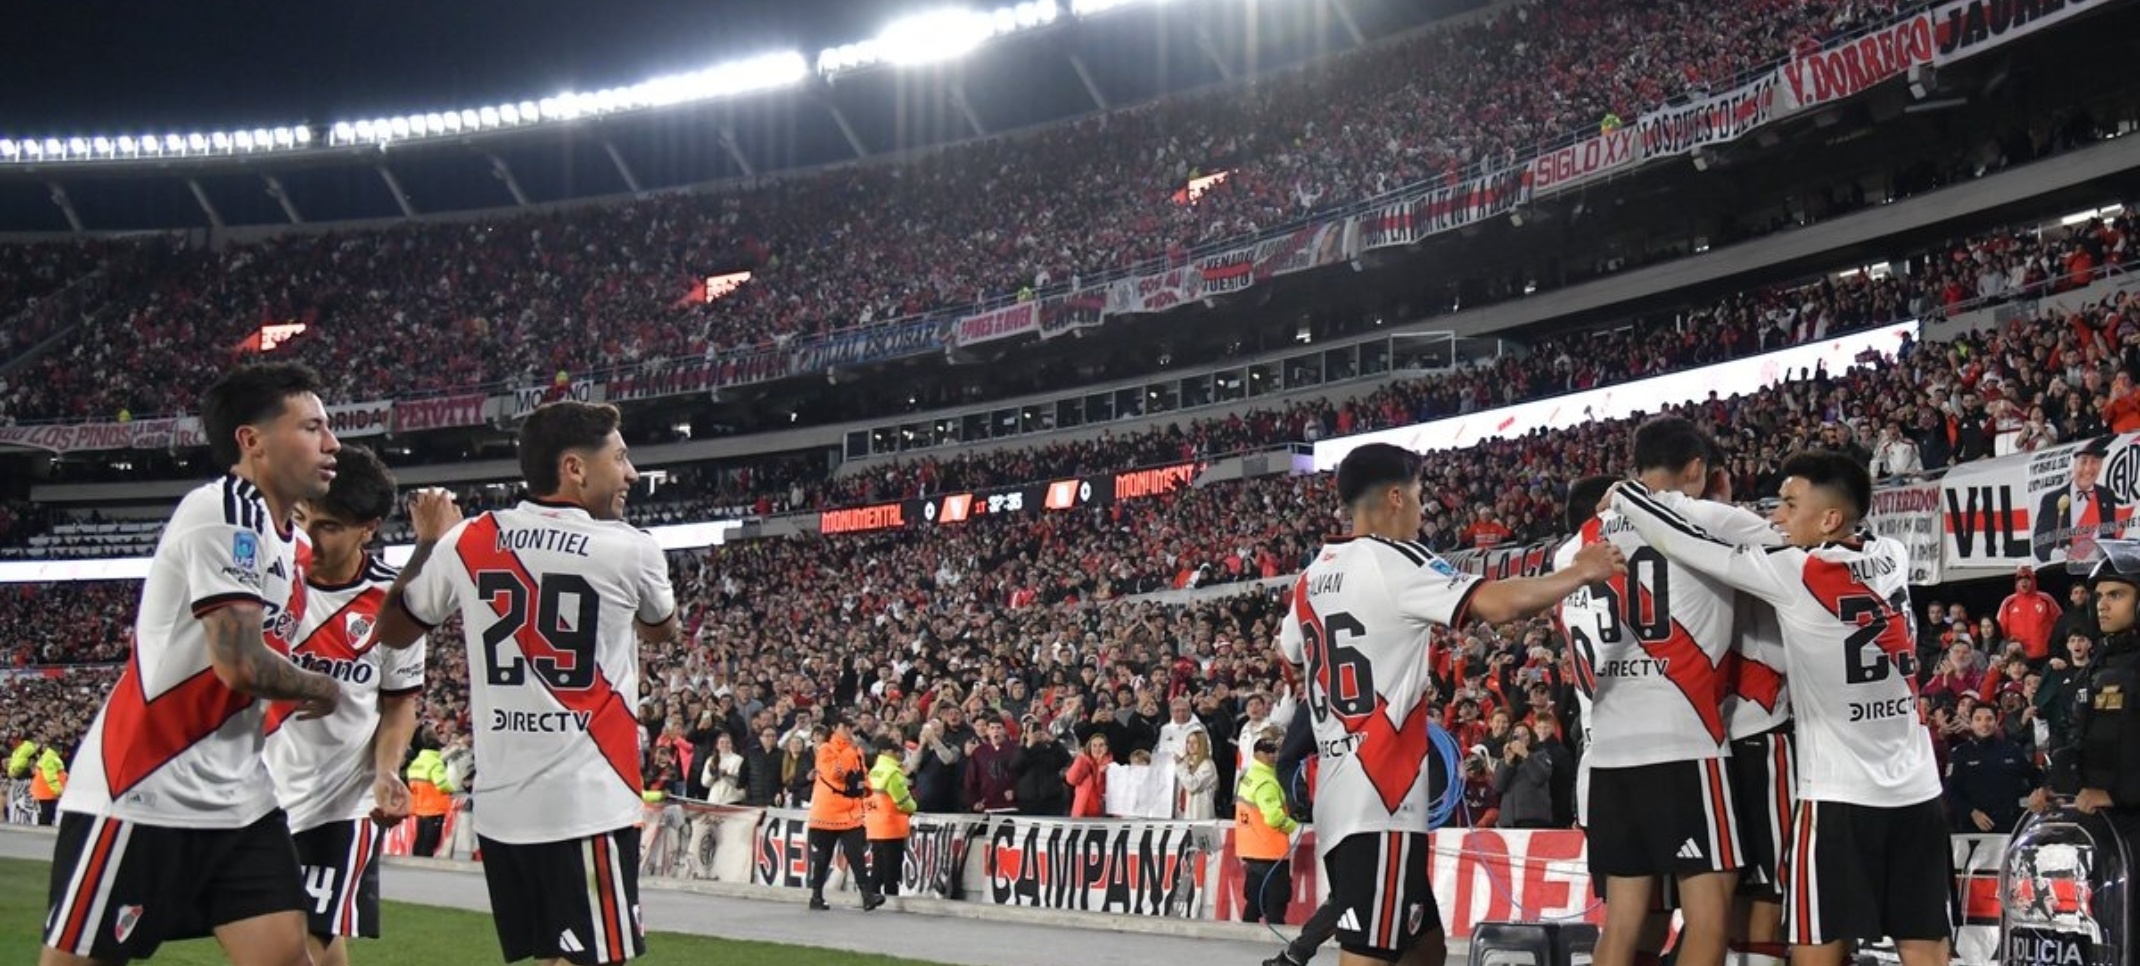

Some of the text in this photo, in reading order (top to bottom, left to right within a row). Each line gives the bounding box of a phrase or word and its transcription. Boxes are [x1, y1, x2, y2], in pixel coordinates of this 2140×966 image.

[1536, 128, 1634, 187] SIGLO XX
[821, 503, 905, 534] MONUMENTAL
[924, 501, 936, 521] 0
[496, 528, 590, 557] MONTIEL
[477, 570, 601, 689] 29
[291, 651, 373, 684] tano
[1302, 610, 1377, 724] 26
[491, 709, 592, 732] DIRECTV
[989, 818, 1197, 918] CAMPANA
